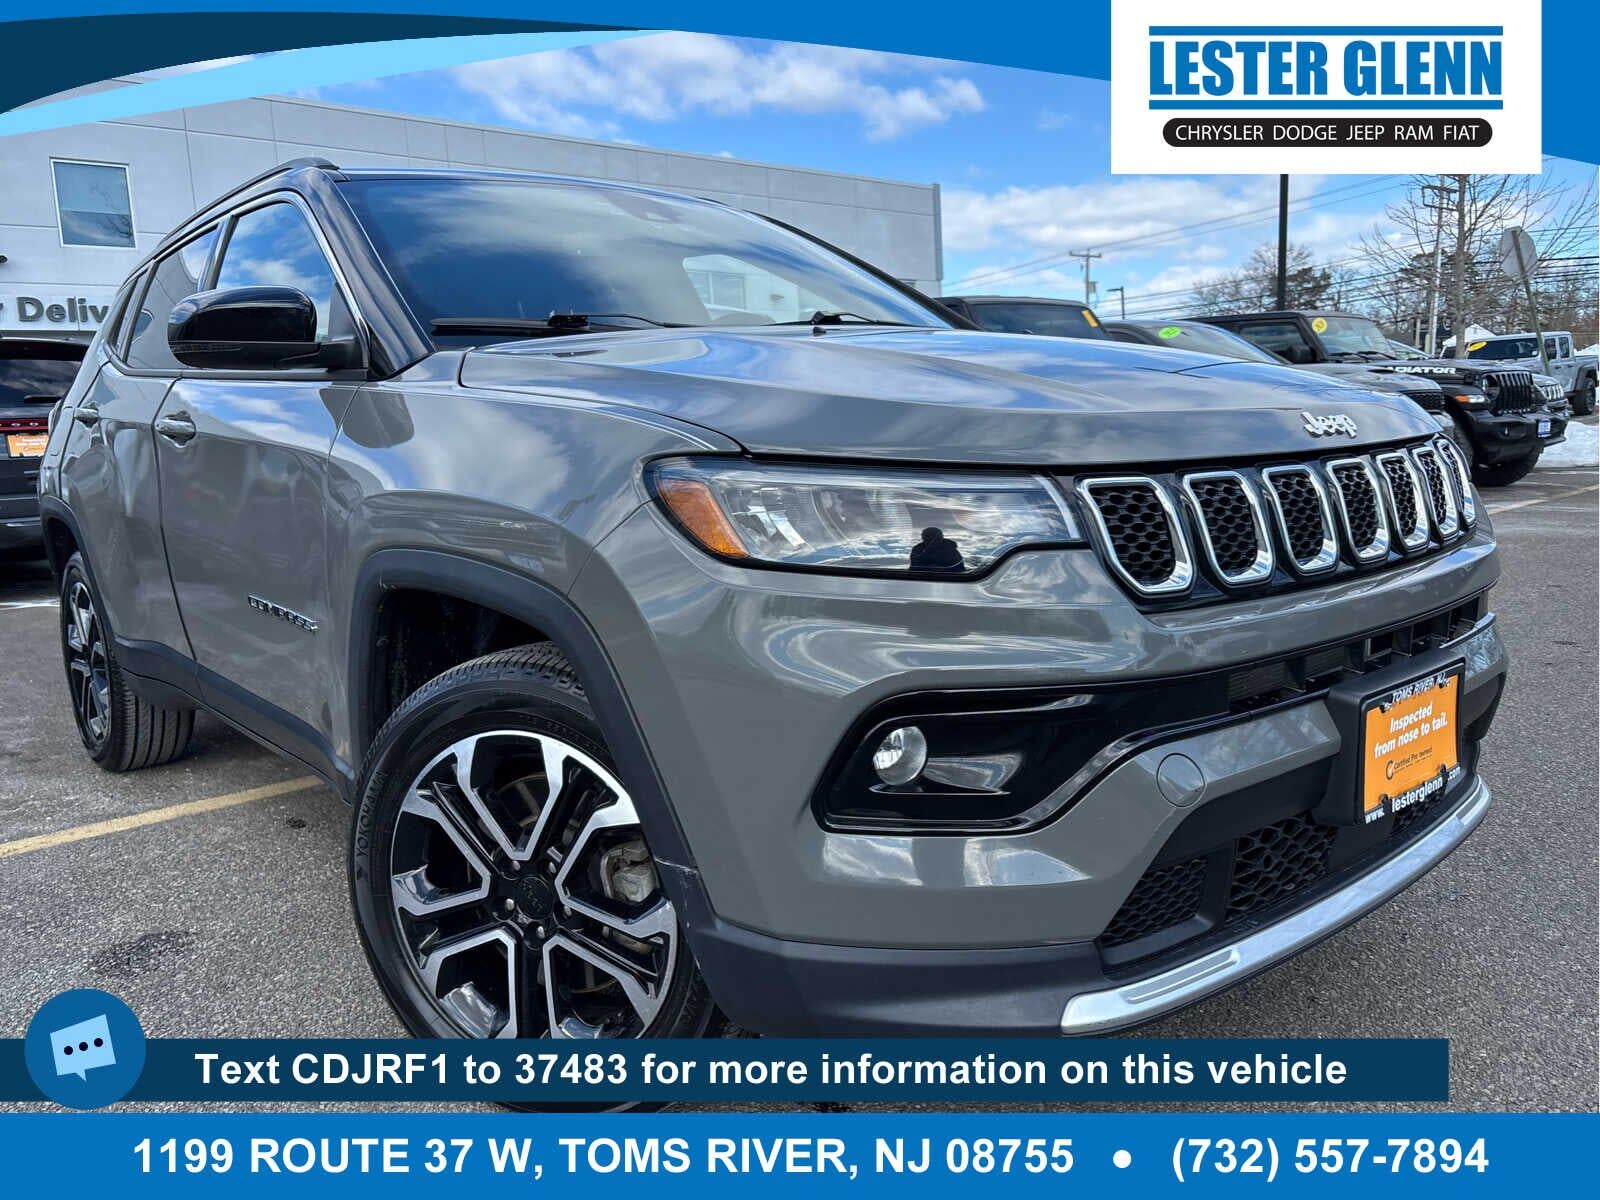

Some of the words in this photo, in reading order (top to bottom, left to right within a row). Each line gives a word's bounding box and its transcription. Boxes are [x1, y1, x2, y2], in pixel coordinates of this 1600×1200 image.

[1301, 411, 1357, 438] Jeep
[1392, 687, 1413, 703] TOMS
[1390, 701, 1433, 733] Inspected
[1374, 738, 1397, 759] from
[1398, 727, 1419, 747] nose
[1421, 723, 1430, 736] to
[1432, 711, 1448, 731] tail.
[1364, 807, 1385, 824] www.
[1391, 776, 1443, 813] lesterglenn
[1447, 766, 1461, 781] .com
